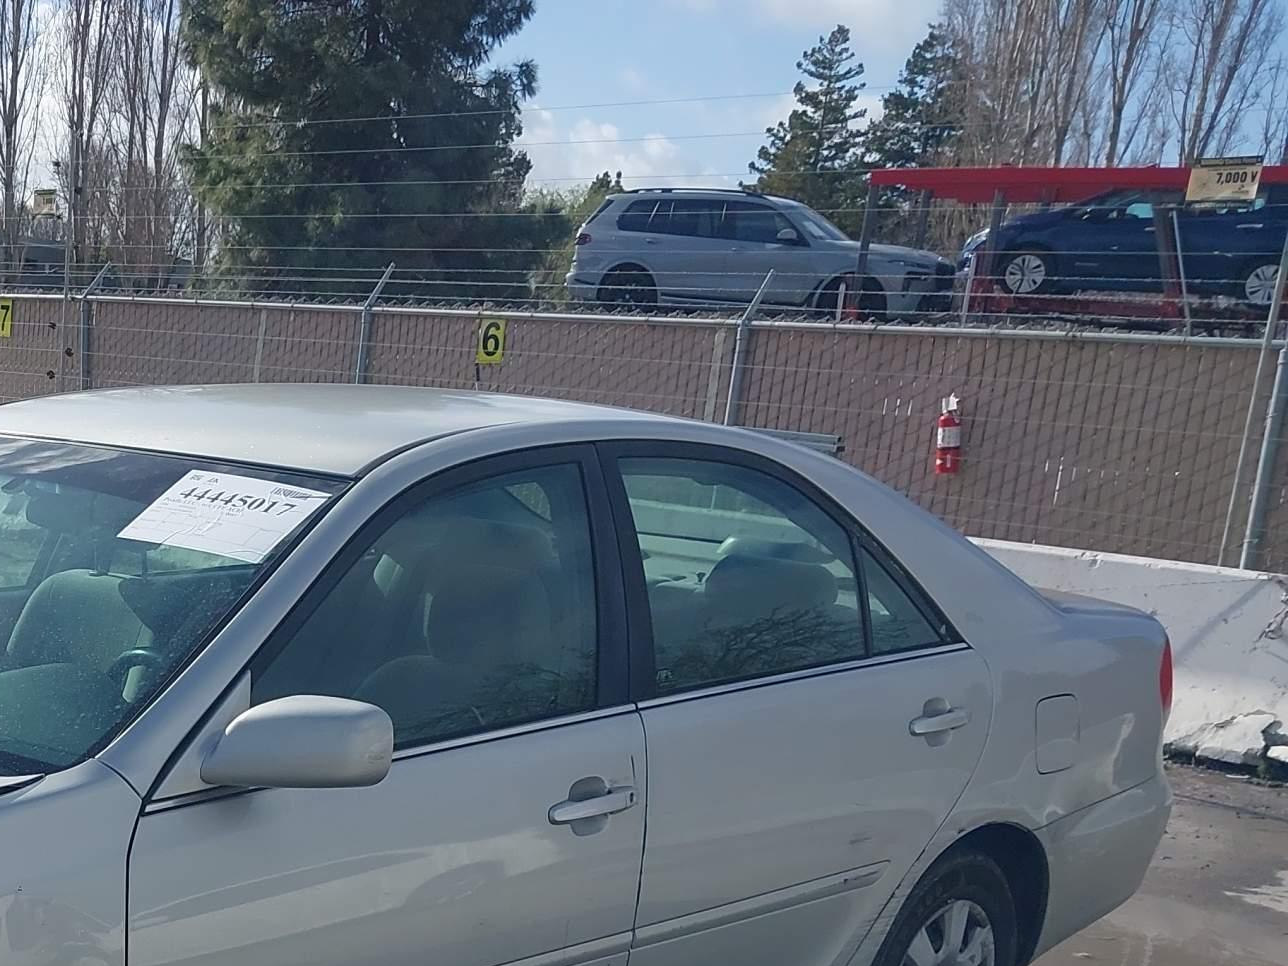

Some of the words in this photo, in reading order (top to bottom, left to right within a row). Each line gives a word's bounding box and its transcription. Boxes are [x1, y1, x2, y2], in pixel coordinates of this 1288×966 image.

[1216, 171, 1248, 185] 7,000
[1251, 170, 1259, 183] V
[0, 304, 10, 331] 7
[482, 321, 501, 357] 6
[179, 486, 297, 517] 44445017
